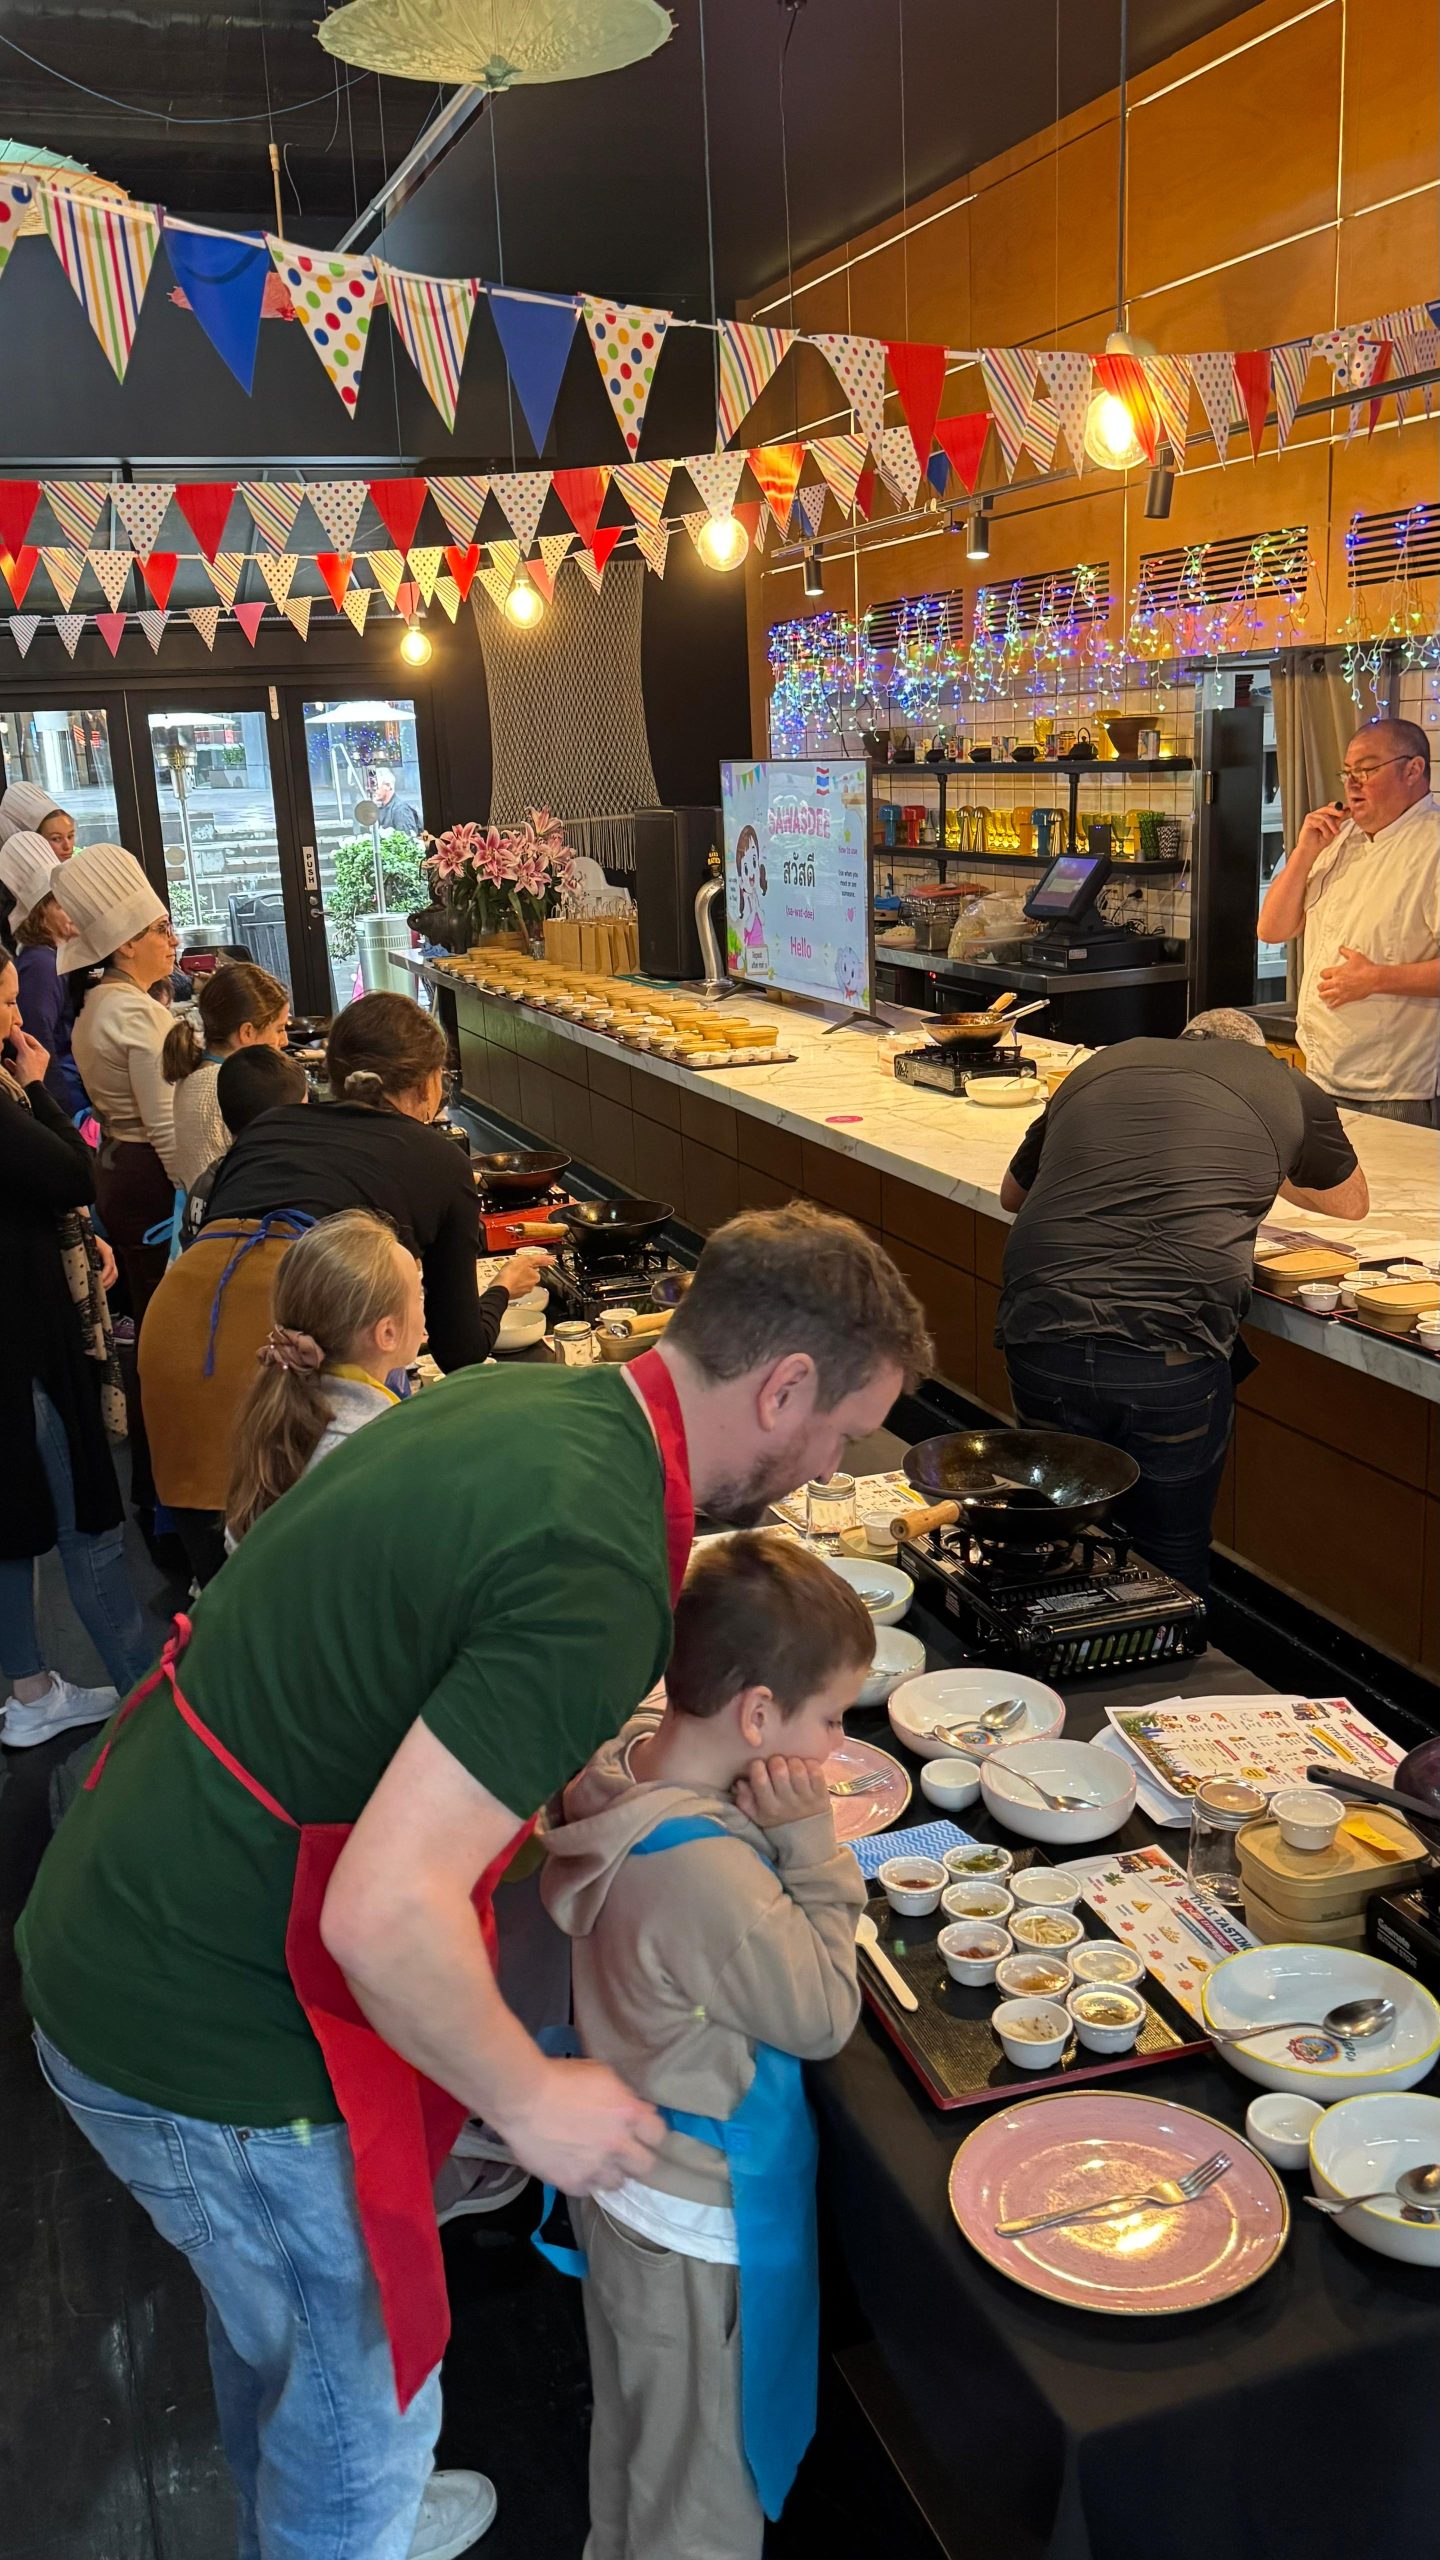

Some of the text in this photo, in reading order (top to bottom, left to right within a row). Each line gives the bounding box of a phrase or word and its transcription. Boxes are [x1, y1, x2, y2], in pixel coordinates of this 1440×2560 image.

[768, 806, 831, 839] SAWASDEE
[306, 853, 315, 884] PUSH
[783, 852, 816, 888] สวัสดี
[790, 936, 812, 959] Hello
[1189, 1896, 1219, 1917] THAI
